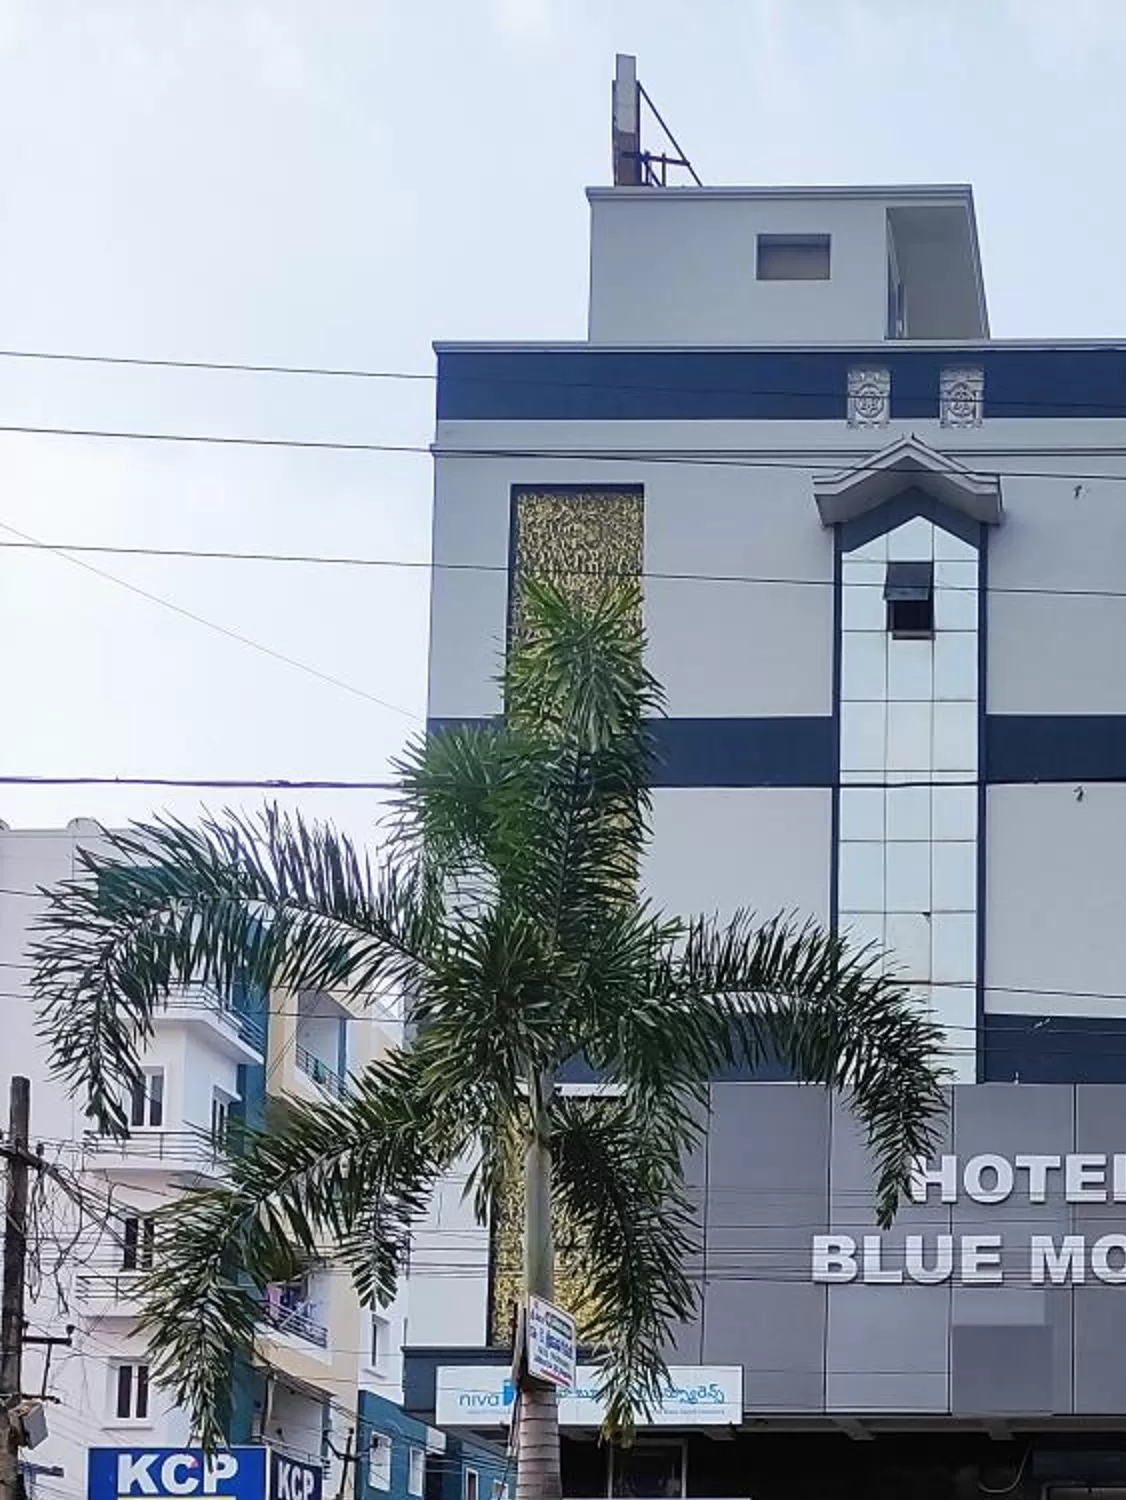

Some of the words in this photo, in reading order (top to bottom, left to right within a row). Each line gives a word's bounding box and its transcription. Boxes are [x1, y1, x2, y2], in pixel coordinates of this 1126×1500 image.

[811, 1234, 1003, 1284] BLUE
[459, 1391, 500, 1406] niva
[118, 1453, 239, 1495] KCP
